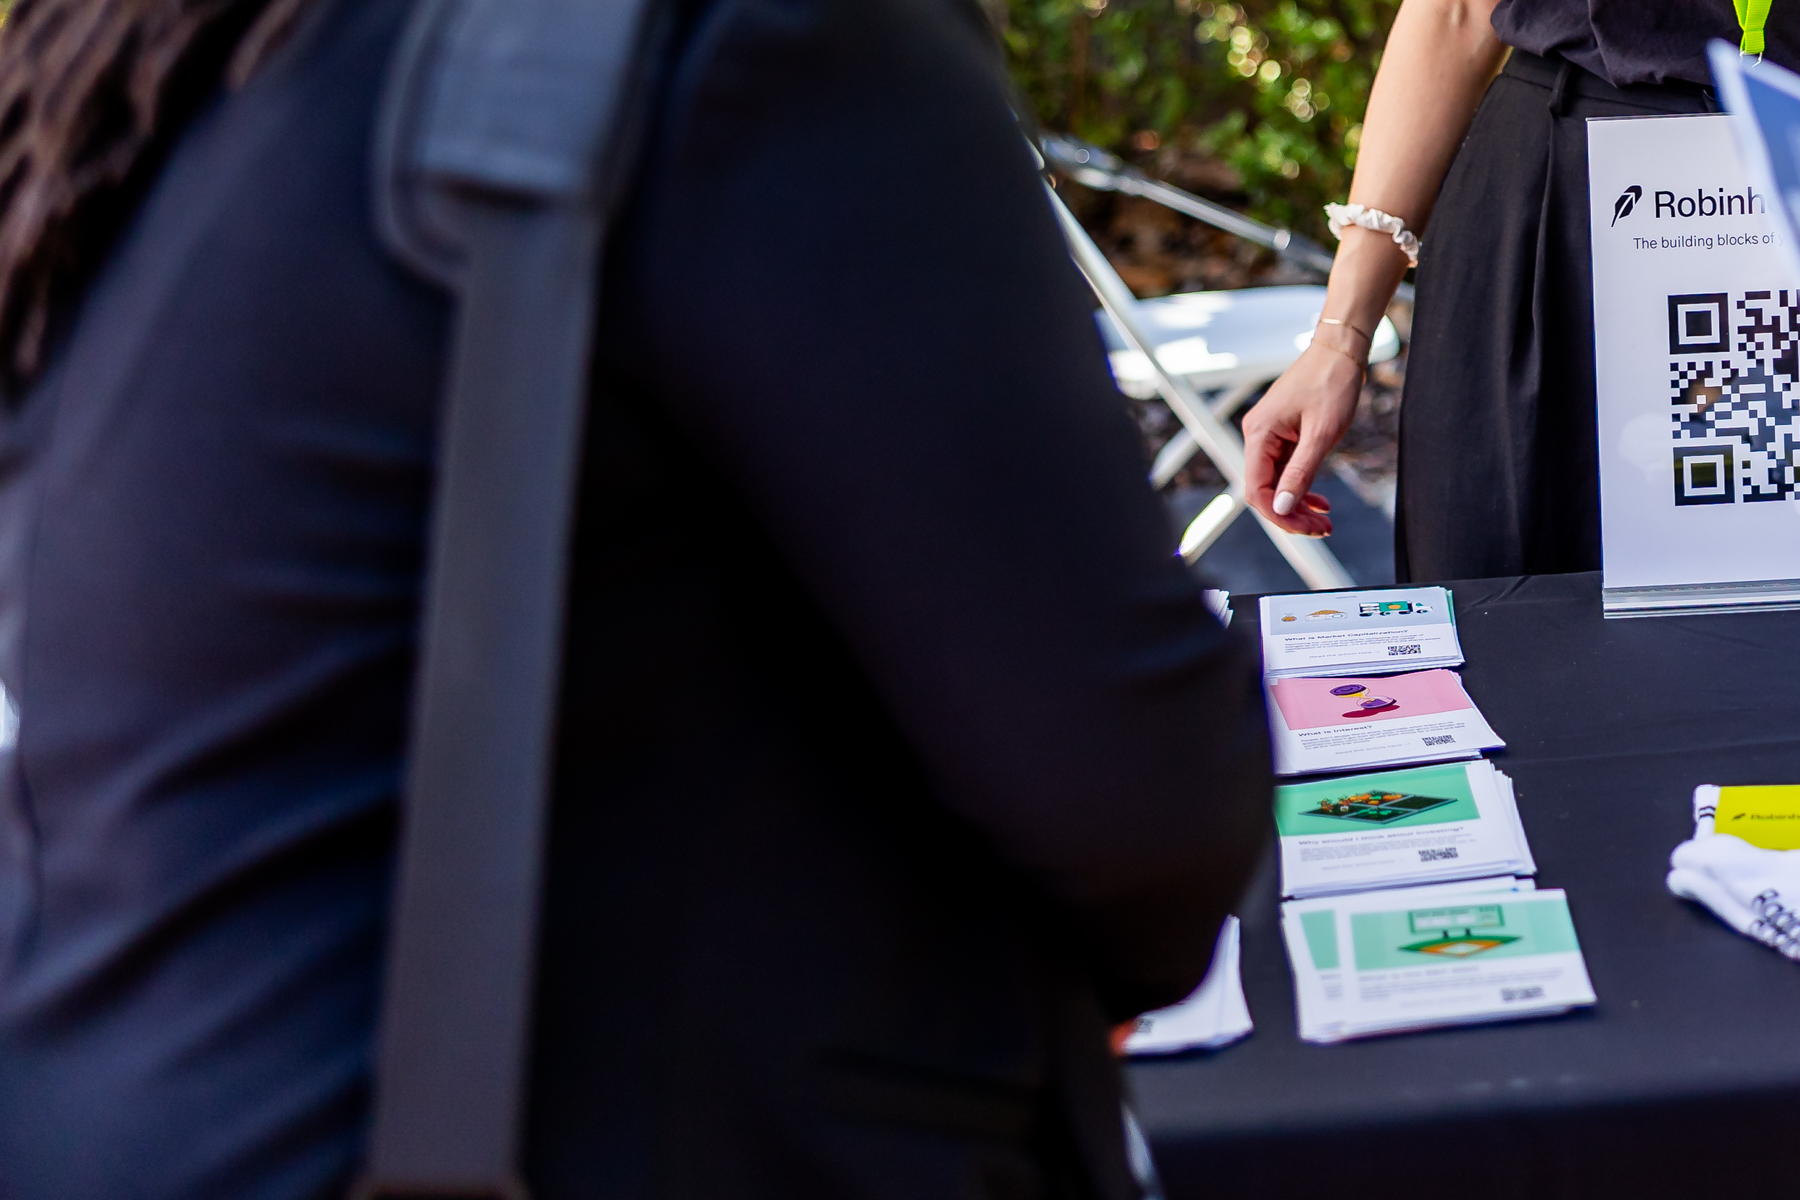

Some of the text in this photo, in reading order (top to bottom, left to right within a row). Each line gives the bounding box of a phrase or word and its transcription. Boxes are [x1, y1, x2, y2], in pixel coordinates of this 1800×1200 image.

[1654, 186, 1766, 219] Robinh
[1633, 237, 1658, 250] The
[1661, 235, 1713, 250] building
[1717, 232, 1759, 246] blocks
[1762, 231, 1775, 244] of
